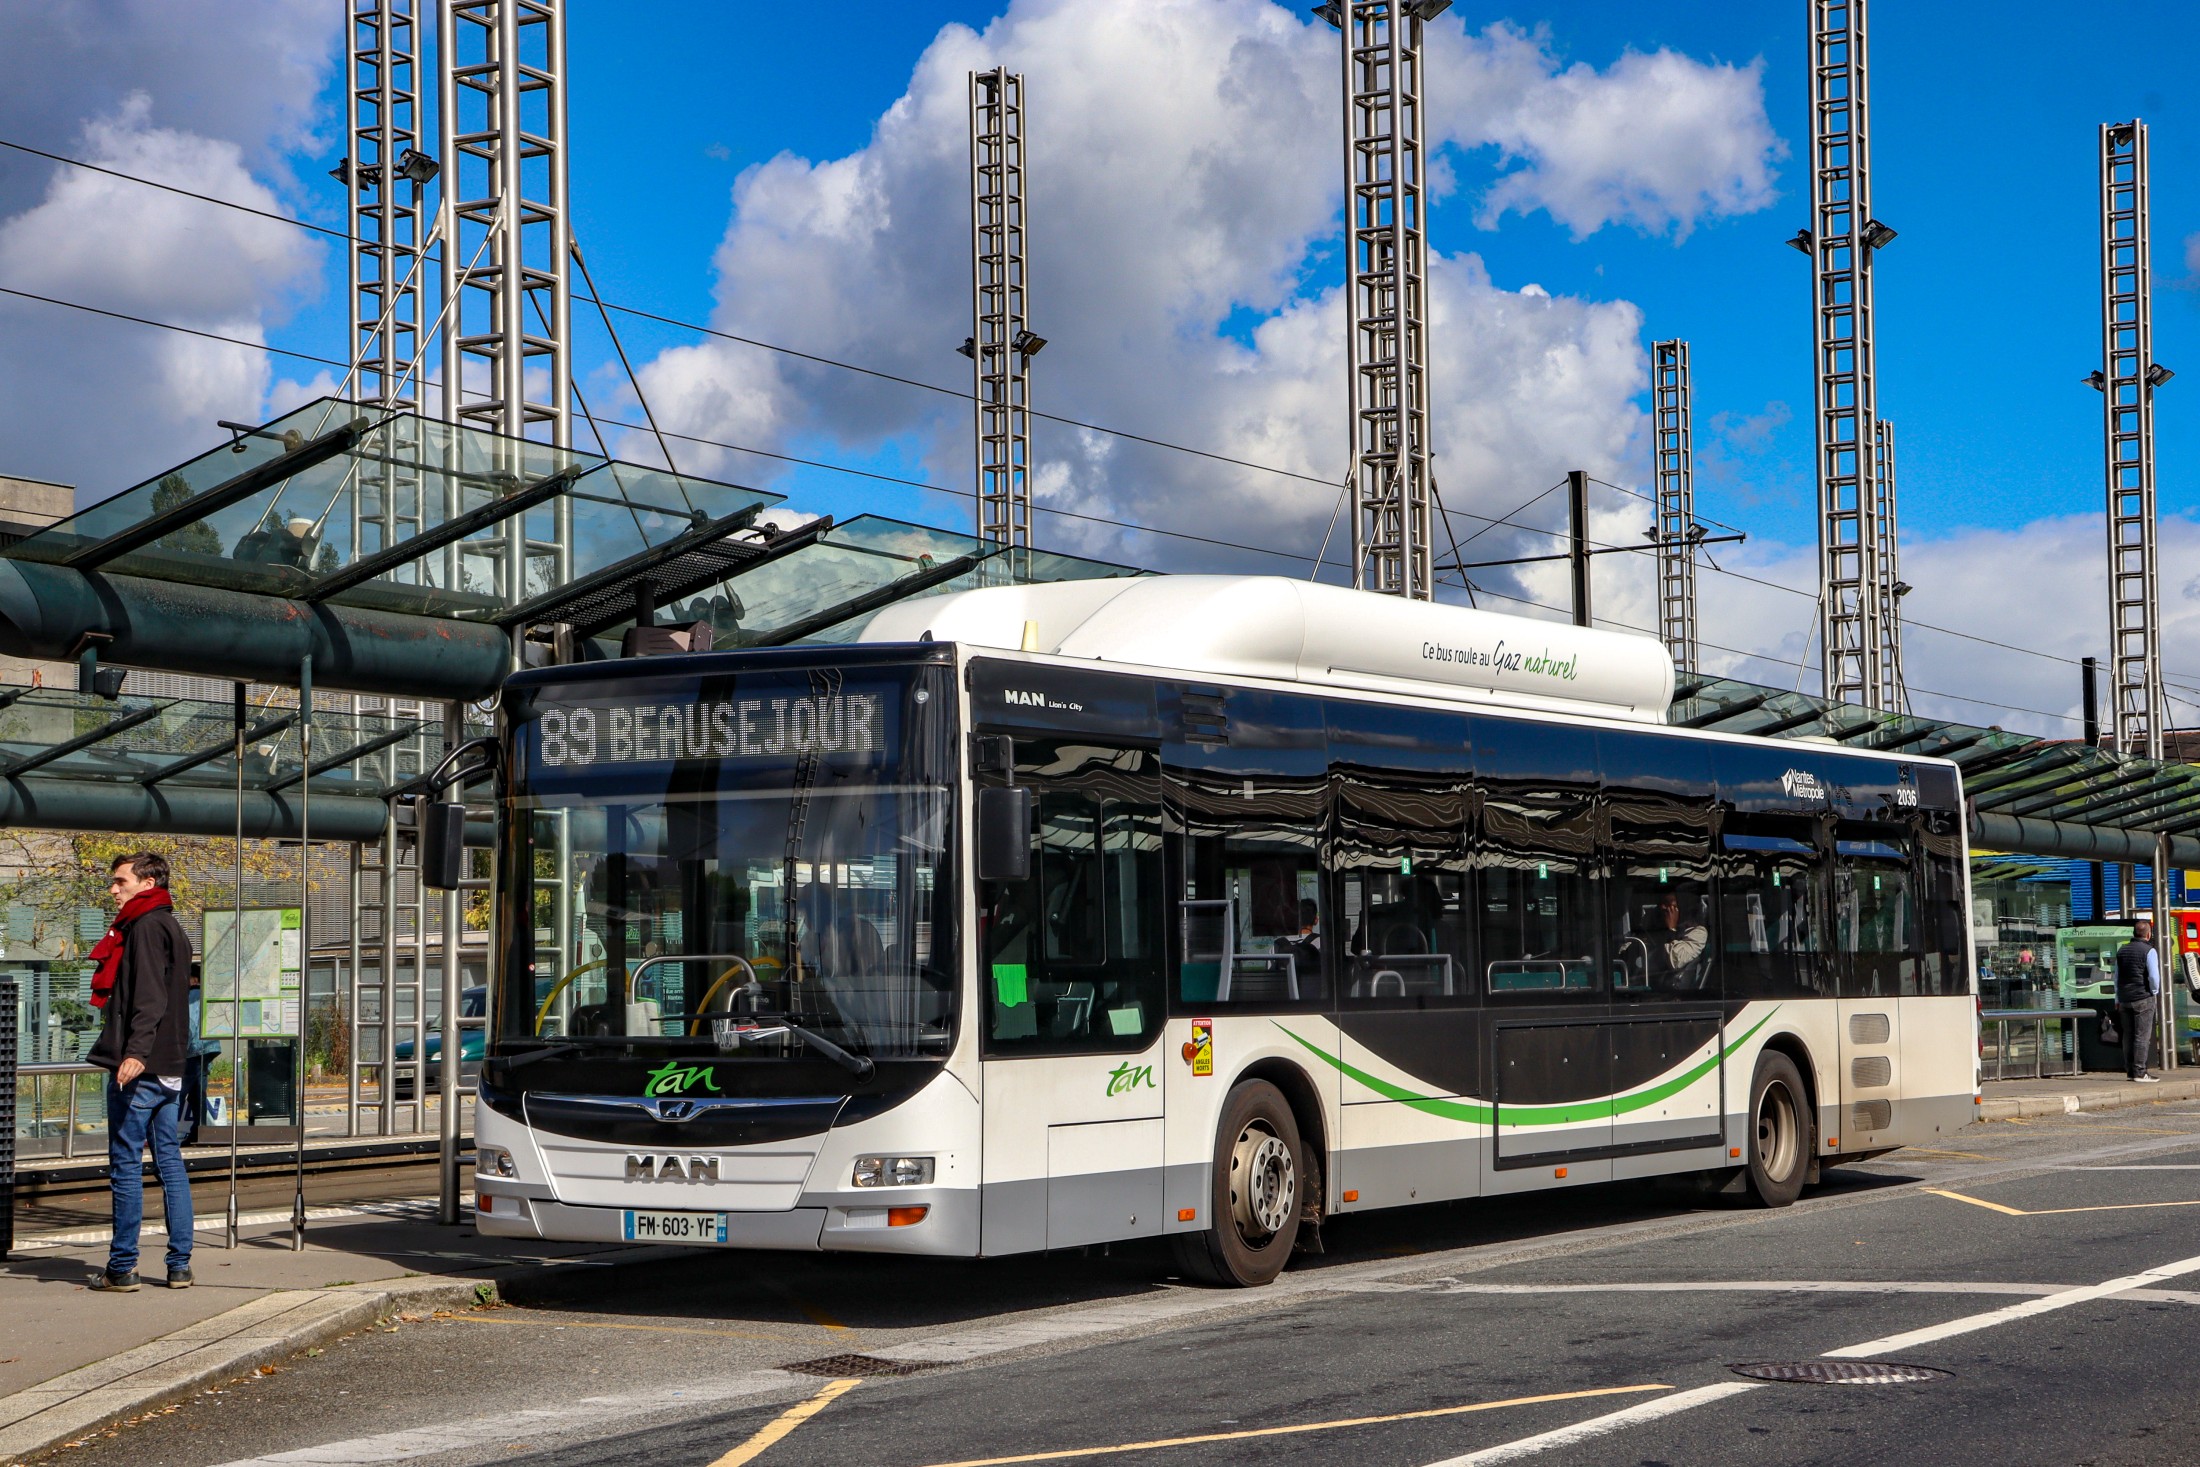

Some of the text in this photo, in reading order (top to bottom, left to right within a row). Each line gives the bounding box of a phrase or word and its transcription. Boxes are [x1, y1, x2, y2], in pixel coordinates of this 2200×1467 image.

[1422, 639, 1578, 681] Ce bus roule au Gaz naturel
[1004, 689, 1083, 712] MAN Lion's City
[540, 694, 873, 766] 89 BEAUSEJOUR
[1791, 768, 1815, 785] Nantes
[1792, 782, 1825, 802] Métropole
[1896, 788, 1917, 807] 2036
[644, 1061, 721, 1098] tan
[1106, 1060, 1157, 1097] tan
[625, 1153, 722, 1181] MAN
[637, 1215, 715, 1238] FM-603-YF
[717, 1230, 726, 1238] 44
